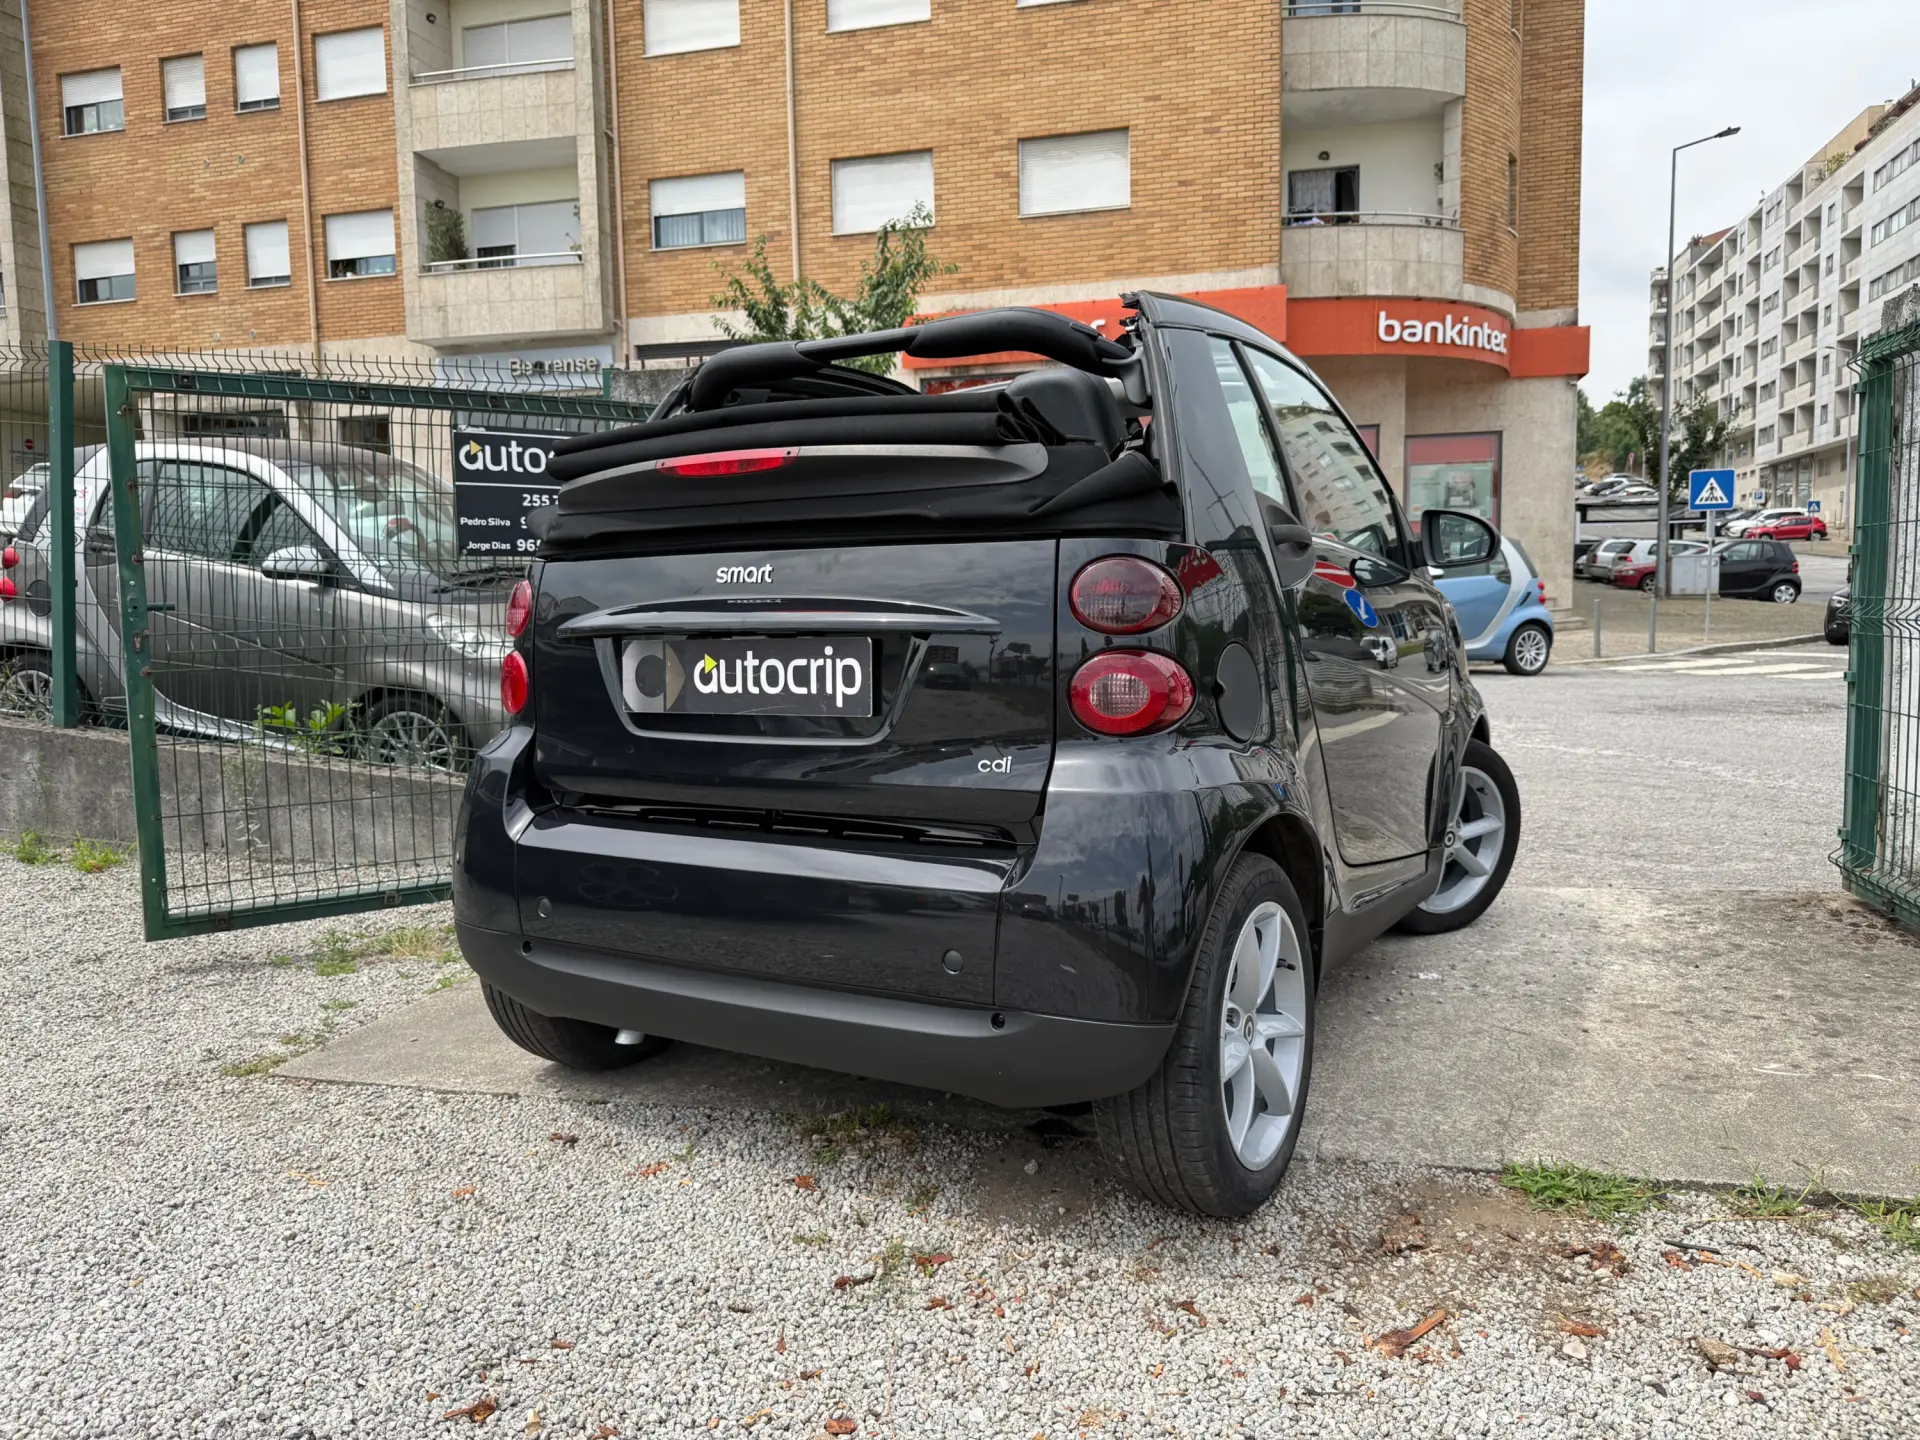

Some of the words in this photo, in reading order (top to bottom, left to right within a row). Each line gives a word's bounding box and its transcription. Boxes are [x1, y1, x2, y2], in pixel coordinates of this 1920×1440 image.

[459, 440, 555, 473] auto
[522, 494, 550, 506] 255
[460, 517, 487, 526] Pedro
[488, 518, 511, 526] Silva
[467, 541, 491, 551] Jorge
[492, 541, 511, 550] Dias
[716, 564, 773, 583] smart
[693, 645, 862, 708] autocrip
[977, 755, 1013, 773] cdi
